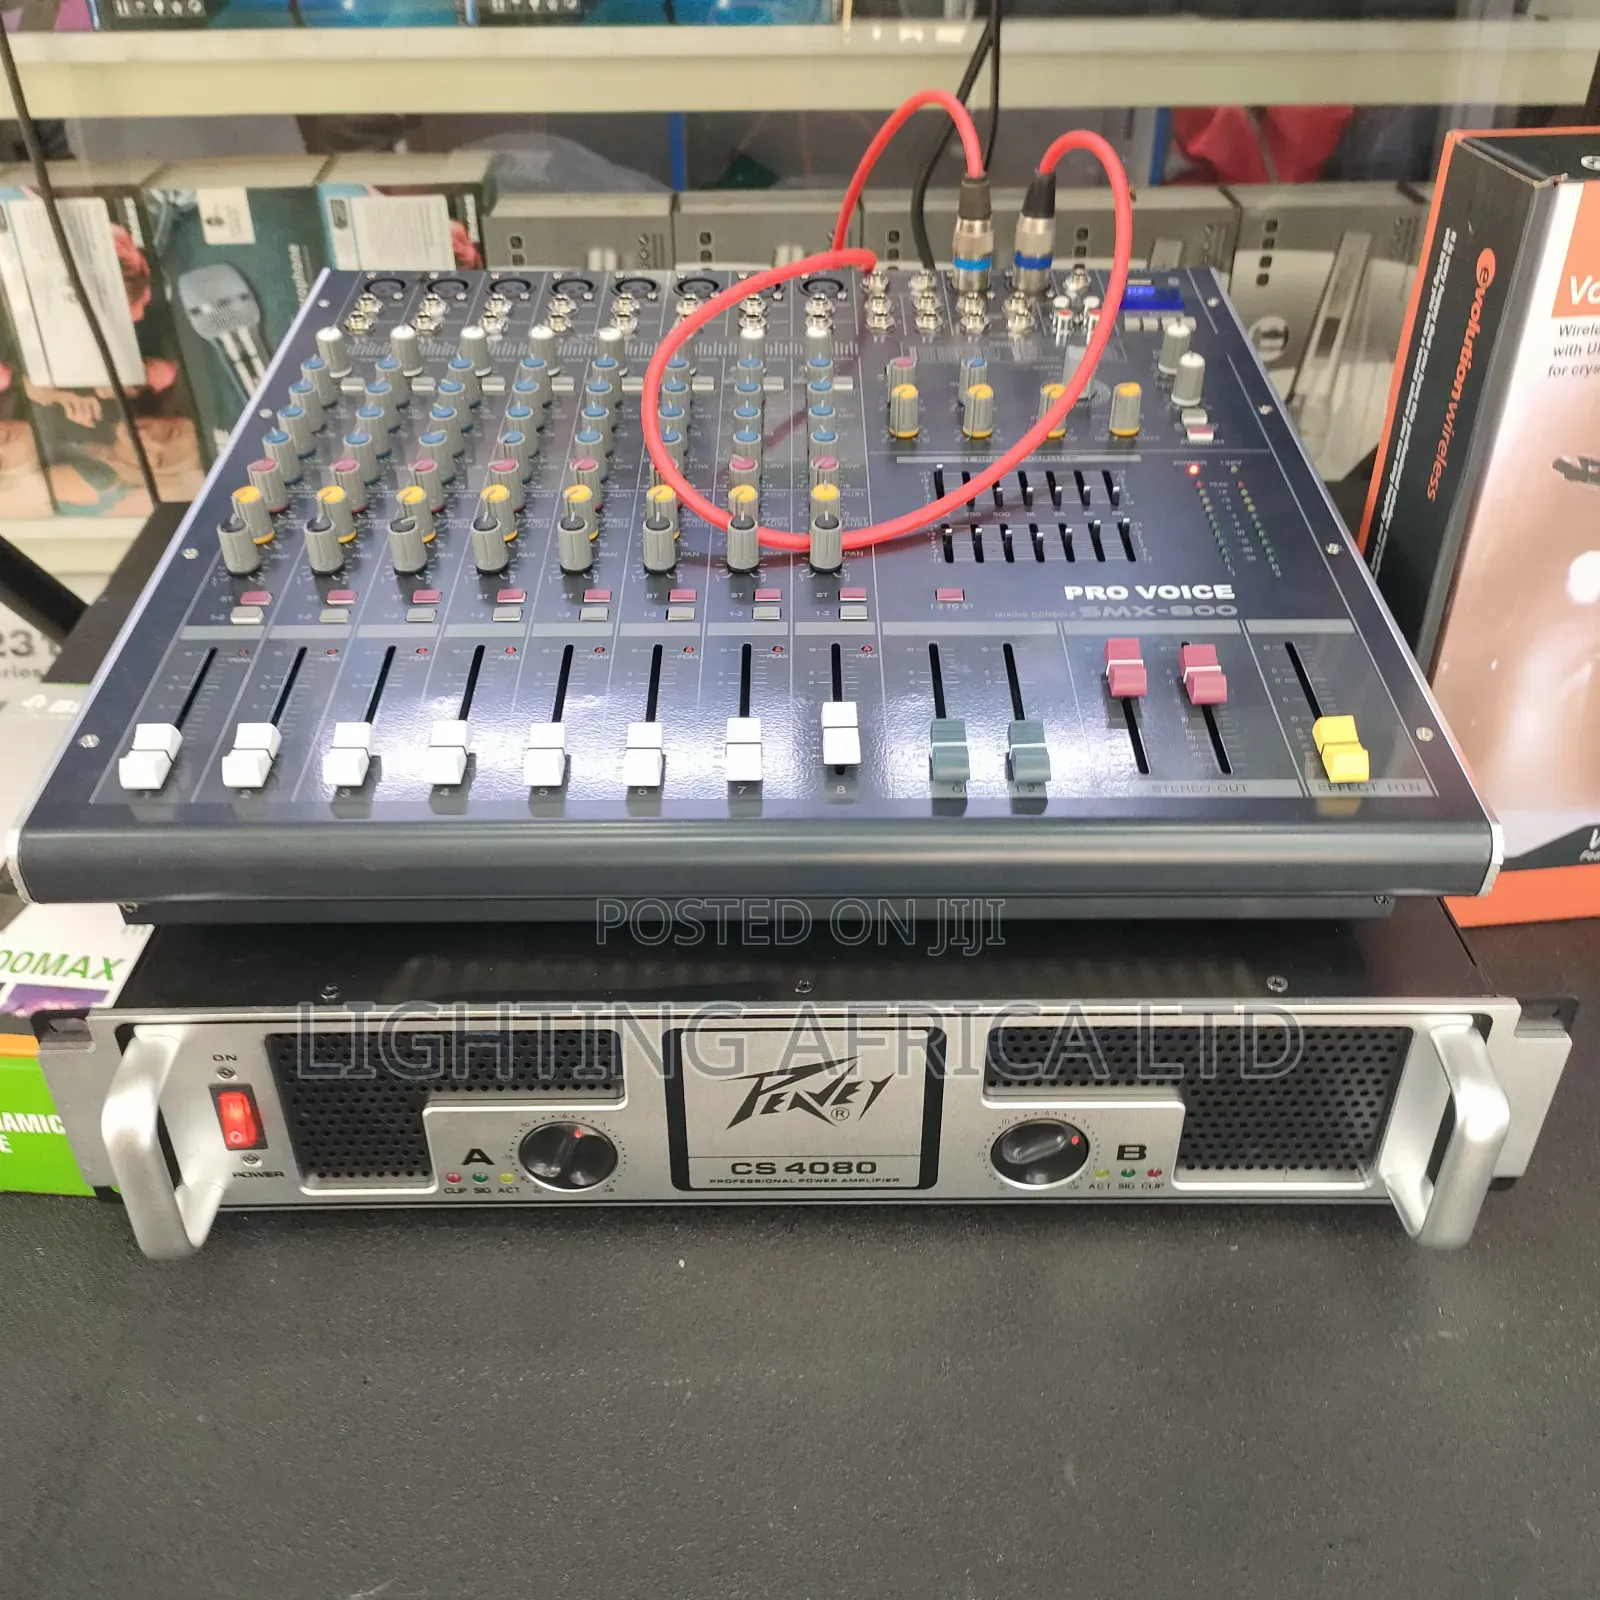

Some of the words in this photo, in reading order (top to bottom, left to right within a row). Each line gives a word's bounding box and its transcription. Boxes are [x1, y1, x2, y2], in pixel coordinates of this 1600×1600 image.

[1553, 342, 1582, 358] with
[1548, 364, 1568, 378] for
[1064, 585, 1128, 600] PRO
[1134, 584, 1235, 600] VOICE
[212, 1054, 238, 1062] ON
[718, 1055, 895, 1131] PEAVEY
[0, 1112, 67, 1134] AMIC
[461, 1148, 495, 1166] A
[1116, 1144, 1147, 1161] B
[232, 1171, 285, 1179] POWER
[731, 1162, 777, 1175] CS
[784, 1161, 877, 1175] 4080
[443, 1187, 467, 1195] CLIP
[473, 1187, 492, 1195] SIG
[498, 1186, 521, 1194] ACT
[1089, 1182, 1111, 1190] ACT
[1118, 1182, 1135, 1190] SIG
[1141, 1182, 1164, 1190] CLIP
